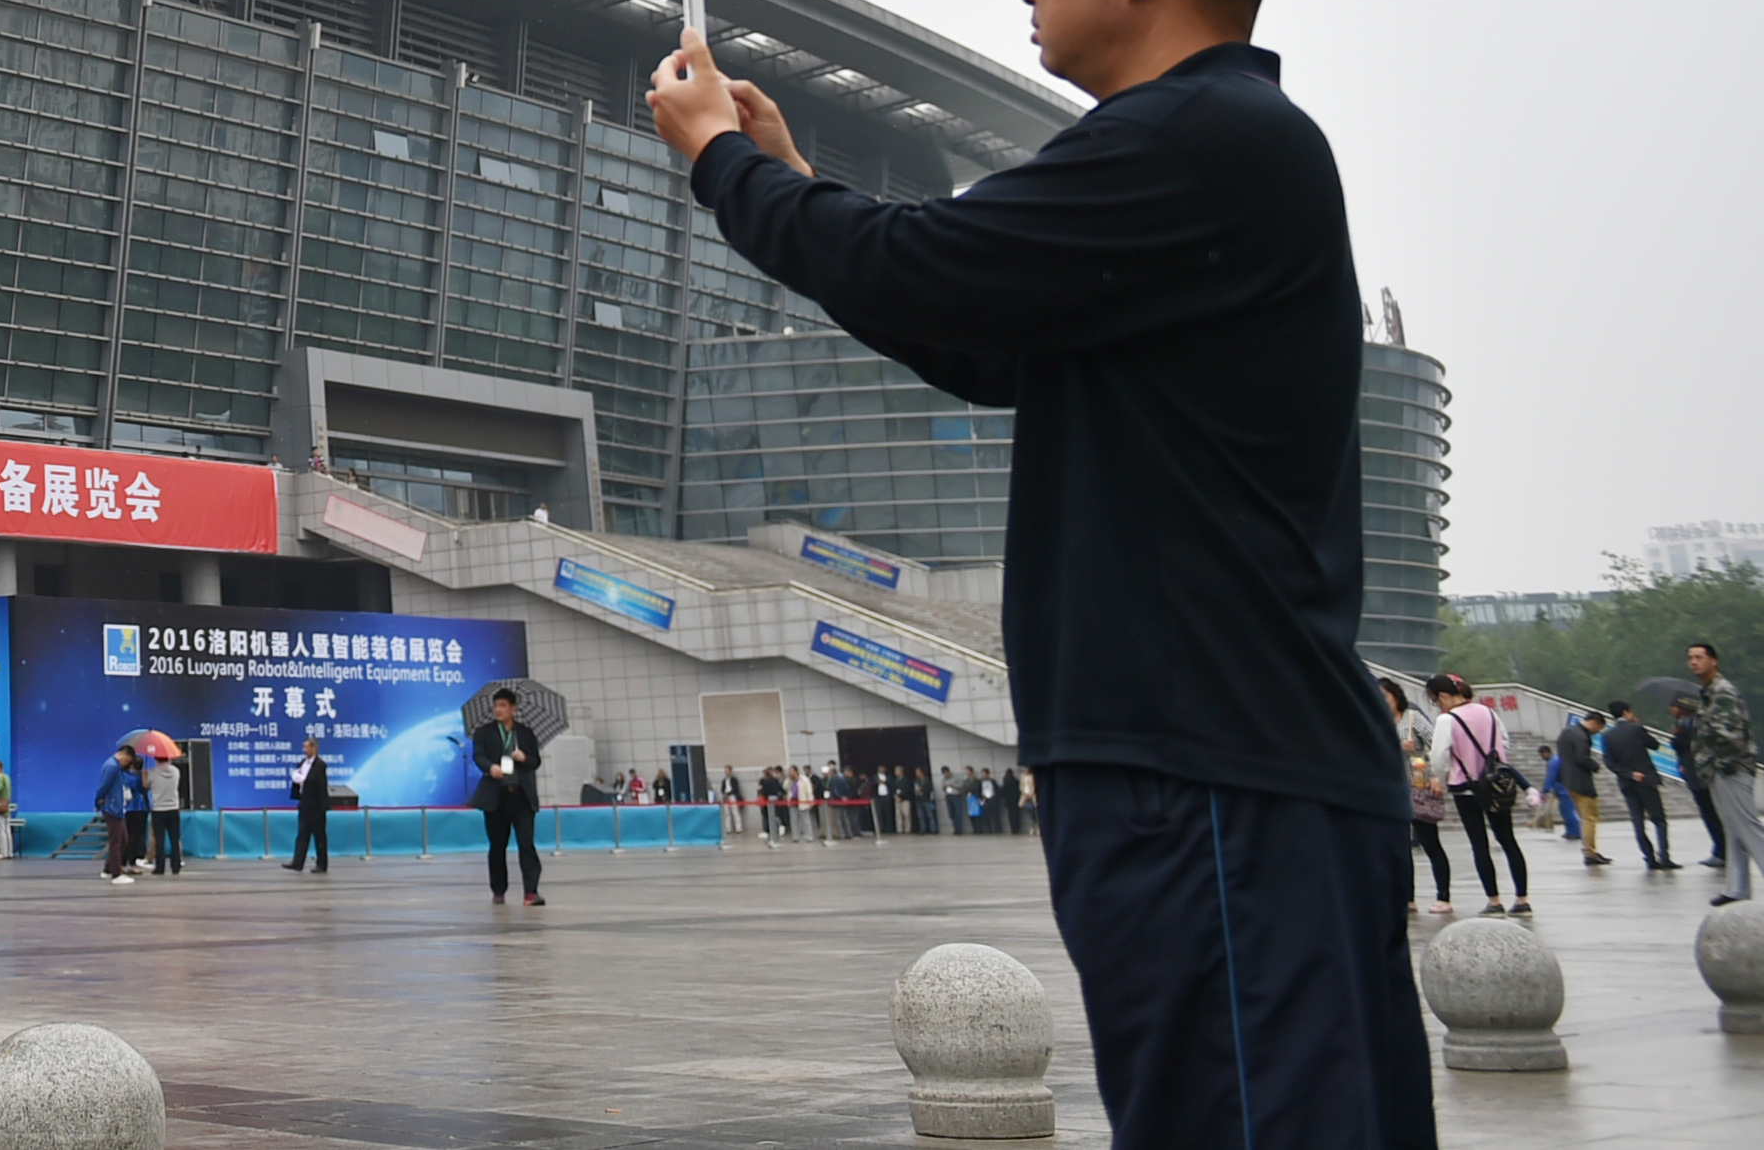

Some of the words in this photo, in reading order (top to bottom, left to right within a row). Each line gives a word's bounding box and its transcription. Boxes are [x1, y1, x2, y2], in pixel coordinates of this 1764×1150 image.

[148, 627, 462, 665] 2016洛阳机器人暨智能装备展览会
[149, 656, 184, 675] 2016
[187, 657, 245, 681] Luoyang
[248, 659, 363, 684] Robot&Intelligent
[366, 663, 431, 685] Equipment
[433, 665, 465, 686] Expo.
[252, 686, 337, 719] 开幕式
